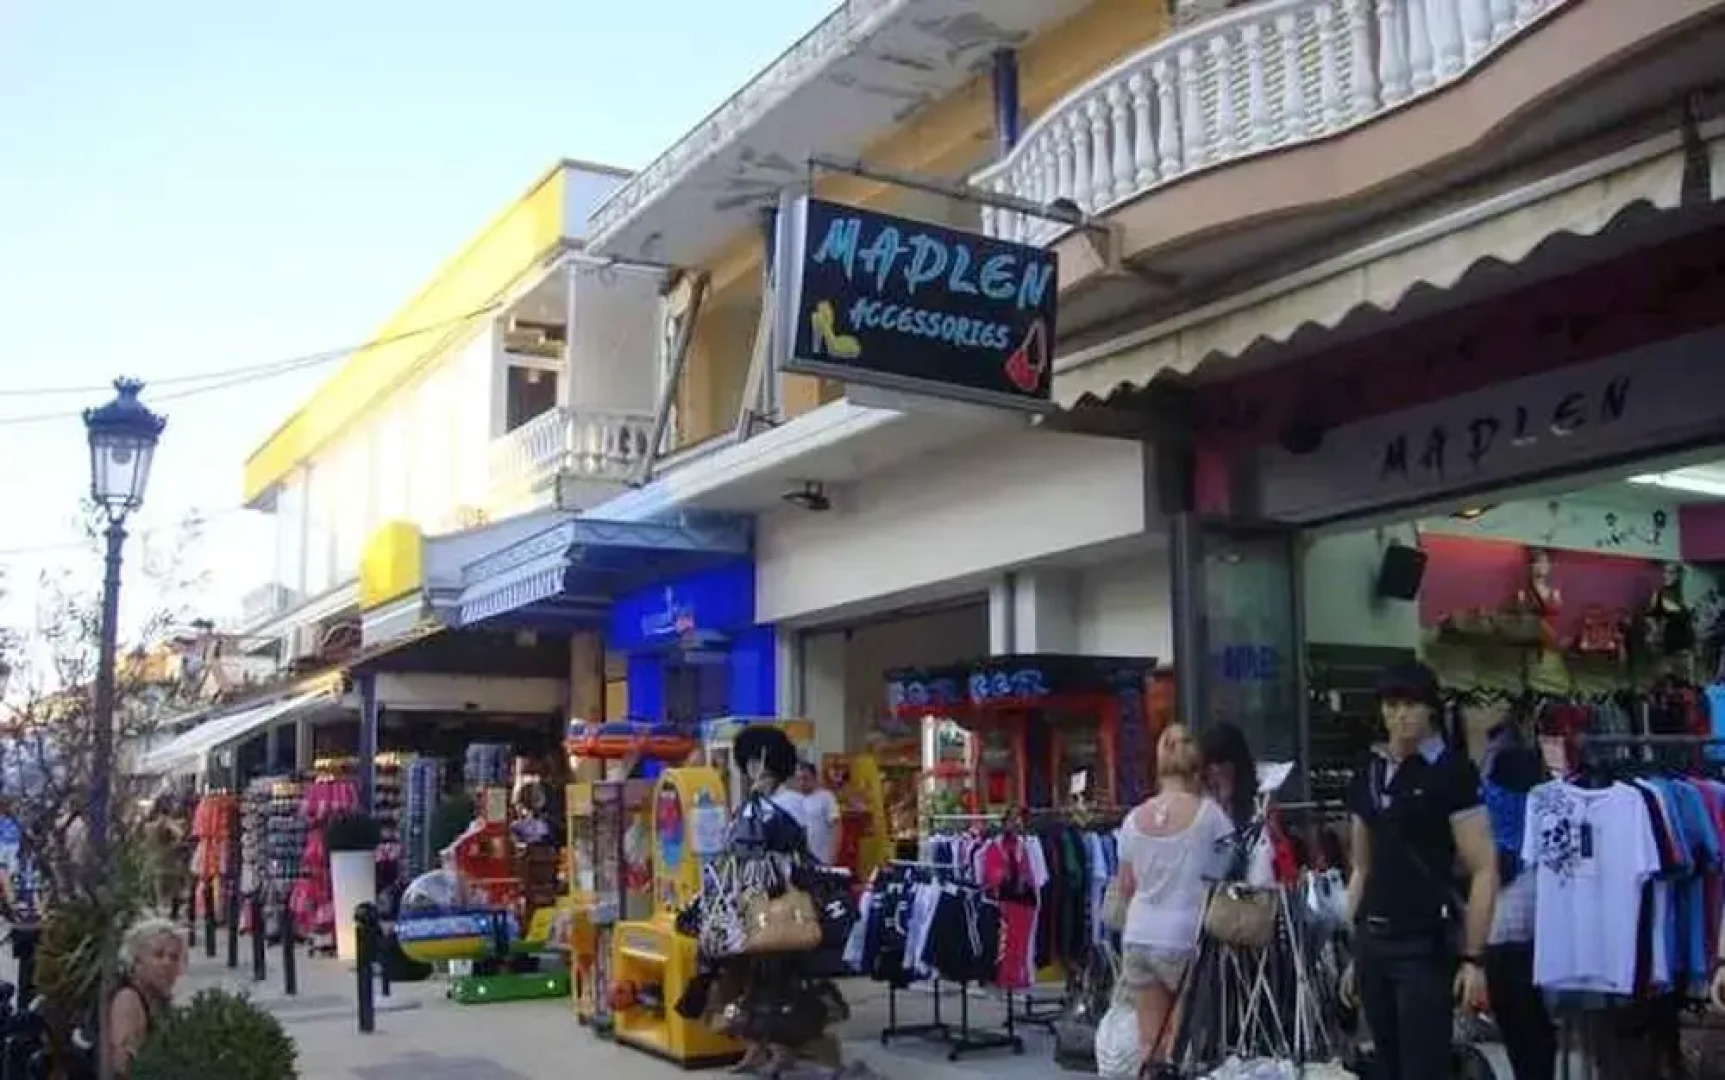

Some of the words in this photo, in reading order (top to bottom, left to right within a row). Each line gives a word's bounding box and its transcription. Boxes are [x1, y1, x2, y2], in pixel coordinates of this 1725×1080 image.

[813, 218, 1053, 310] MADLEN
[850, 296, 1010, 349] ACCESSORIES
[1380, 374, 1630, 482] MADLEN
